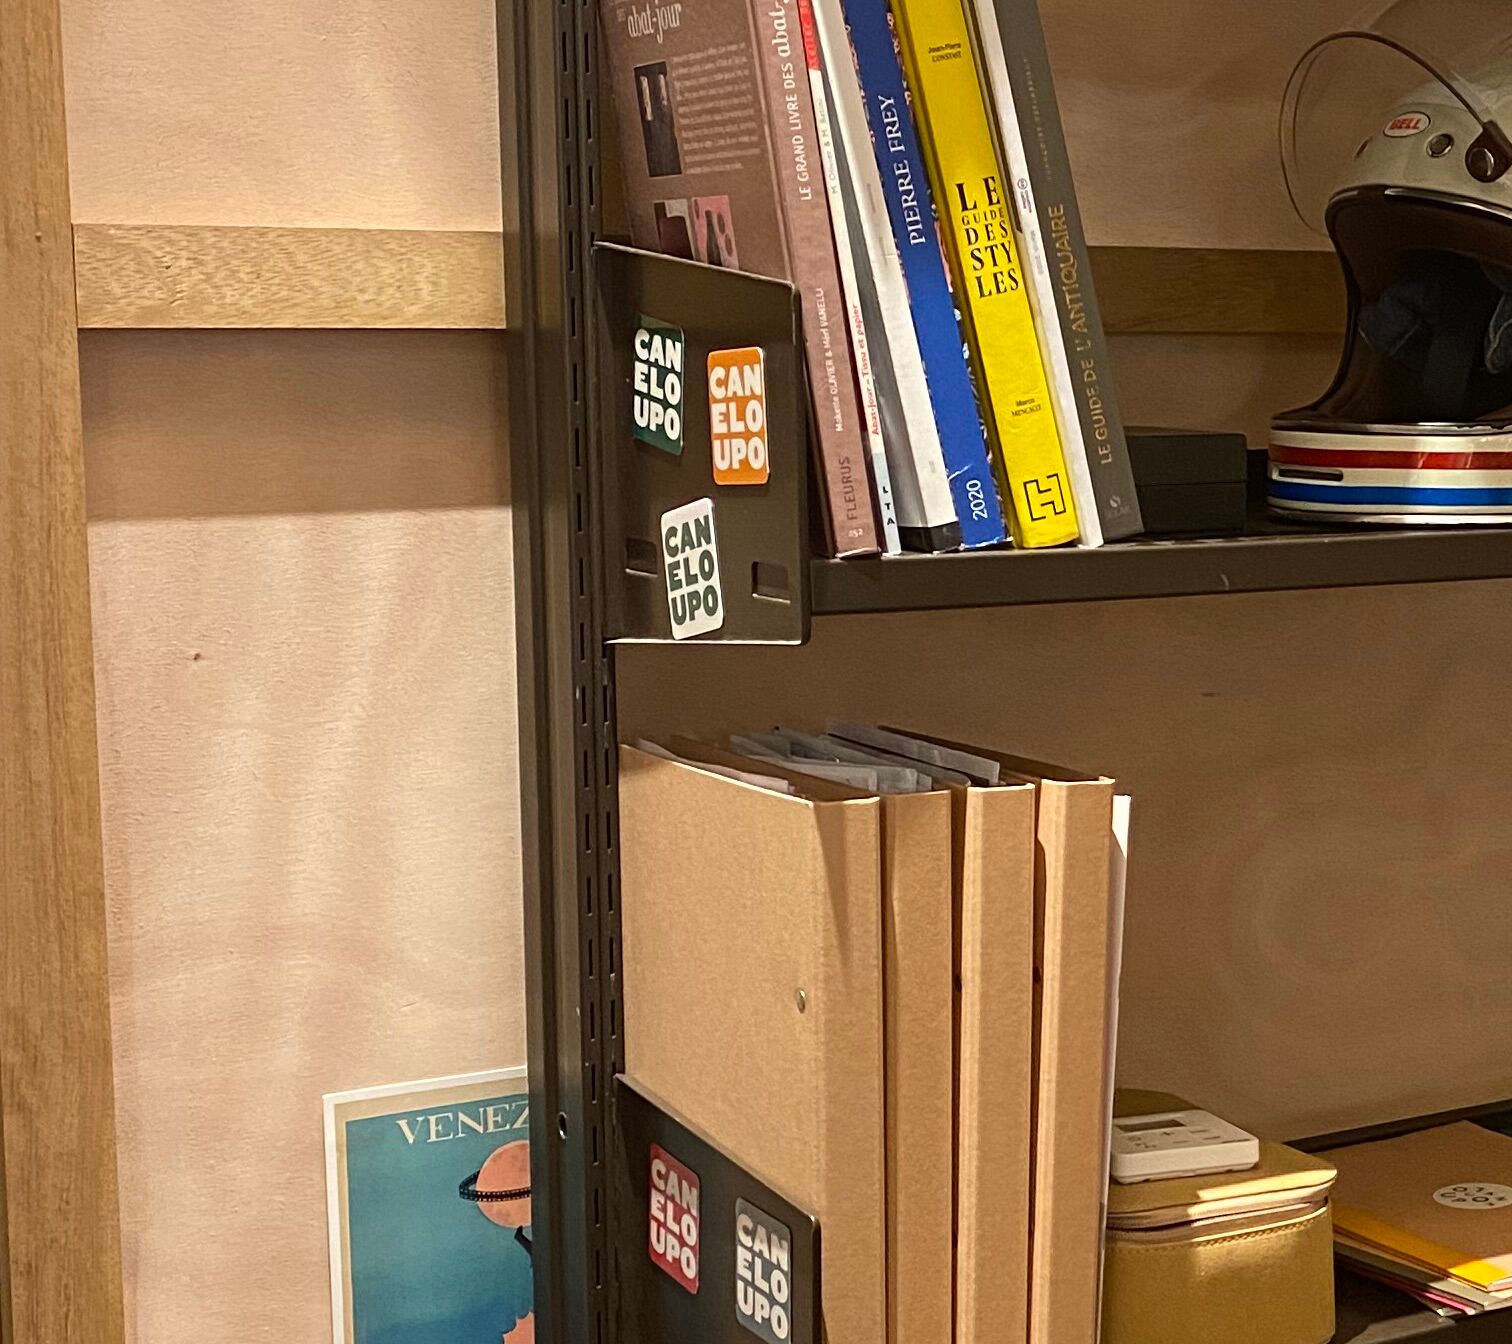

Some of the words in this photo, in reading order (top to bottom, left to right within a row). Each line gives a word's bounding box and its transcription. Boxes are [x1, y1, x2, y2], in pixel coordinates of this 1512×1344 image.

[780, 61, 796, 89] DES
[785, 92, 803, 131] LIVRE
[877, 95, 905, 153] FREY
[791, 134, 810, 183] GRAND
[798, 184, 813, 201] LE
[893, 159, 926, 246] PIERRE
[955, 175, 1001, 213] LE
[961, 207, 1005, 226] GUIDE
[964, 219, 1009, 248] DES
[970, 240, 1013, 272] STY
[974, 267, 1020, 299] LES
[852, 304, 865, 336] papier
[633, 327, 682, 373] CAN
[1081, 359, 1095, 382] DE
[633, 360, 682, 406] ELO
[709, 363, 762, 400] CAN
[633, 395, 682, 441] UPO
[710, 400, 764, 434] ELO
[1088, 386, 1109, 444] GUIDE
[713, 435, 766, 471] UPO
[1097, 447, 1112, 464] LE
[838, 455, 858, 521] FLEURUS
[965, 479, 989, 521] 2020
[664, 514, 712, 558] CAN
[667, 549, 715, 592] ELO
[670, 584, 719, 626] UPO
[651, 1158, 698, 1218] CAN
[650, 1187, 697, 1247] ELO
[650, 1219, 697, 1280] UPO
[736, 1212, 789, 1272] CAN
[736, 1244, 789, 1304] ELO
[736, 1279, 789, 1340] UPO
